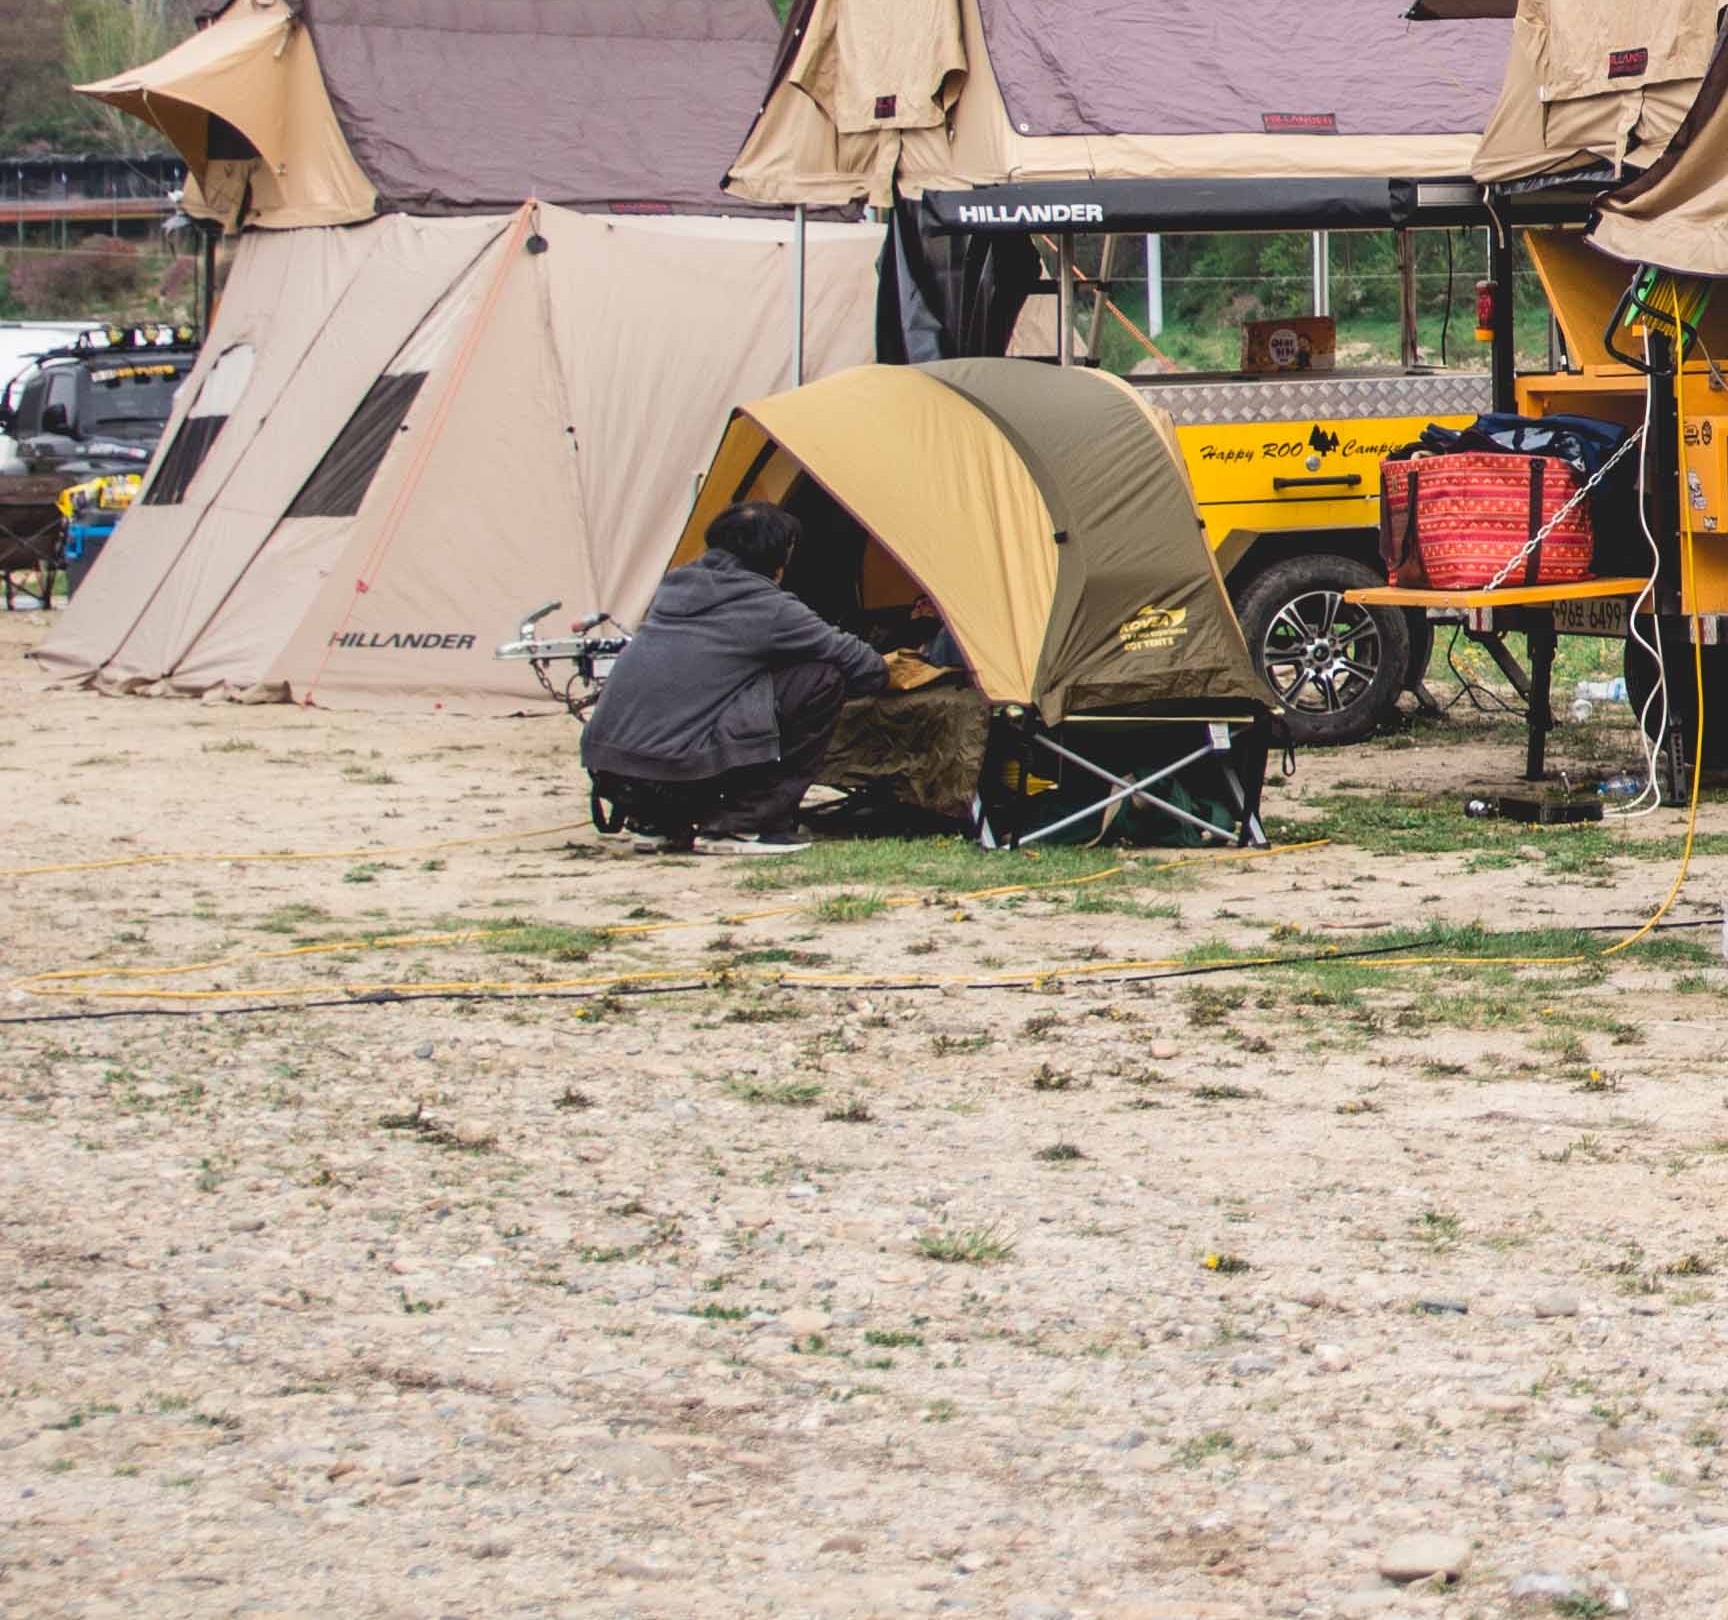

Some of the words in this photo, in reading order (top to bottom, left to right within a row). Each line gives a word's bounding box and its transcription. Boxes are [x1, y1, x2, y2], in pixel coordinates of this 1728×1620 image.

[959, 203, 1104, 223] HILLANDER
[1200, 445, 1254, 464] Happy
[1261, 441, 1304, 459] ROO
[1590, 600, 1621, 630] 6499
[328, 631, 477, 650] HILLANDER
